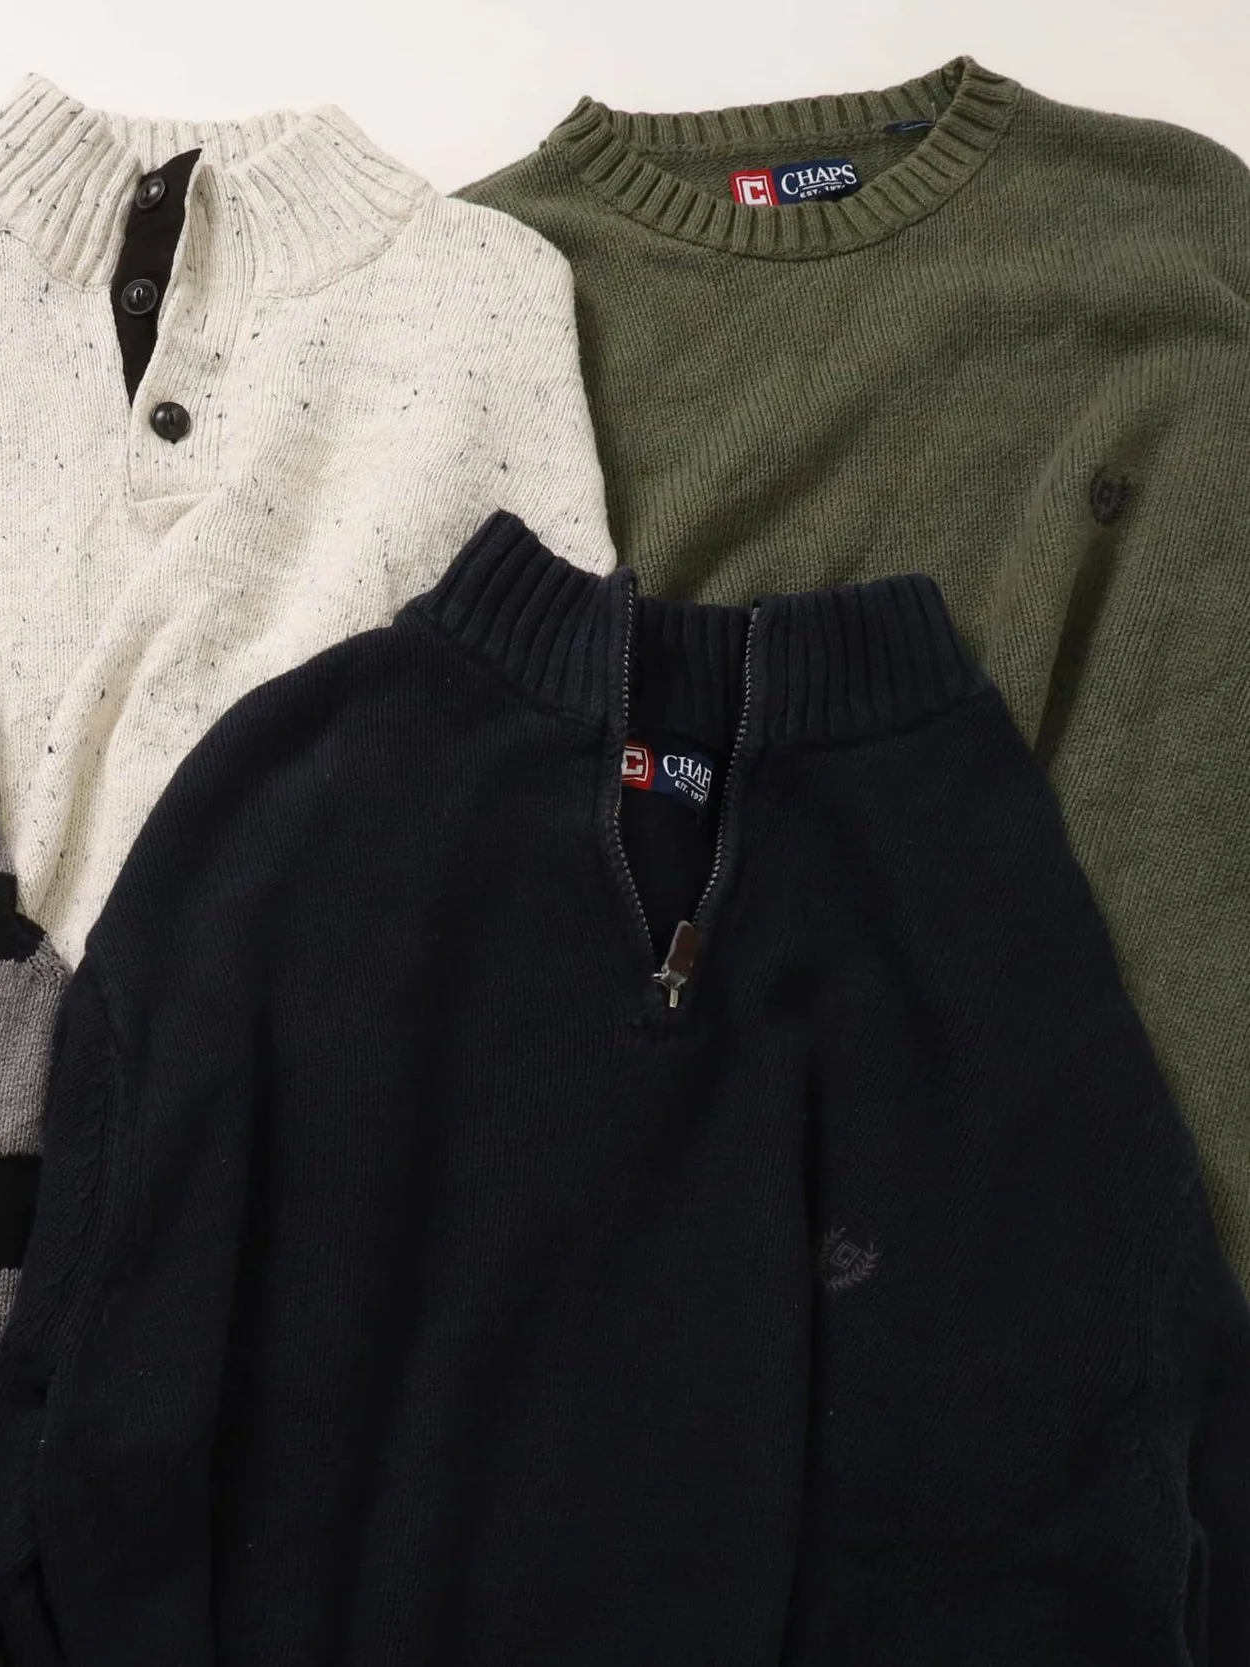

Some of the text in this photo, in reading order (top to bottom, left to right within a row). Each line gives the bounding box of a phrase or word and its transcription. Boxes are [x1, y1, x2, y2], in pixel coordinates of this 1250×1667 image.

[781, 164, 858, 195] CHAPS
[663, 755, 712, 796] CHAP
[690, 790, 705, 804] 197
